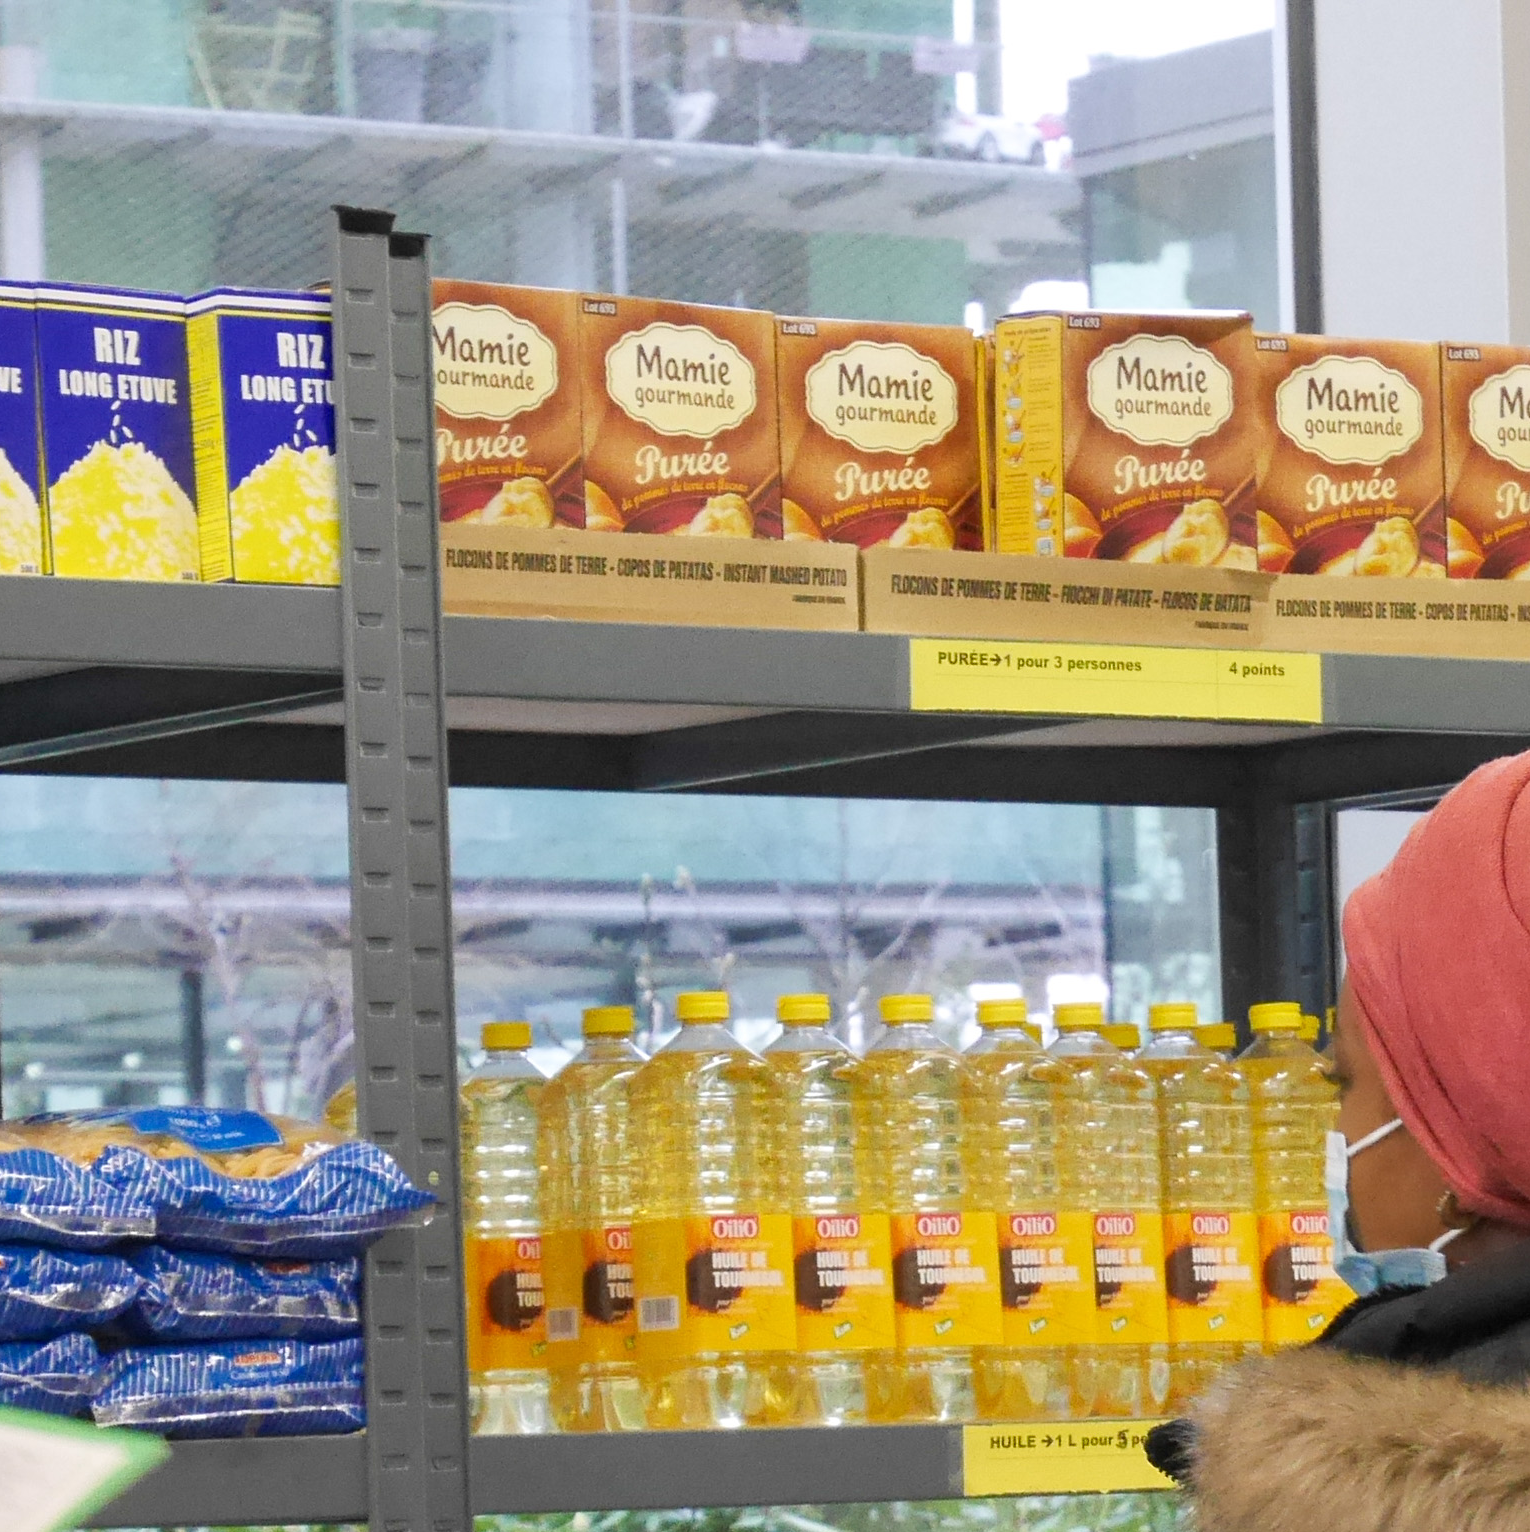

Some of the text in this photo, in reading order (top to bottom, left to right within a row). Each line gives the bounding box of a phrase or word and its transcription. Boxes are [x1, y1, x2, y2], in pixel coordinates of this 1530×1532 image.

[1069, 316, 1100, 328] Lot 693
[94, 327, 141, 366] RIZ
[276, 332, 325, 370] RIZ
[433, 326, 530, 366] Mamie
[1257, 339, 1270, 350] Lot
[1449, 348, 1480, 360] Lot 693
[636, 344, 731, 386] Mamie
[1117, 356, 1208, 393] Mamie
[59, 369, 177, 405] LONG ETUVE
[241, 374, 297, 403] LONG
[437, 369, 535, 391] ourmande
[837, 363, 934, 401] Mamie
[635, 387, 735, 410] gourmande
[1115, 397, 1212, 420] gourmande
[1307, 377, 1400, 414] Mamie
[835, 404, 937, 426] gourmande
[1304, 417, 1403, 439] gourmande
[634, 441, 730, 484] Purée
[1114, 449, 1207, 495] Purée
[834, 457, 931, 501] Purée
[1305, 467, 1398, 513] Purée
[445, 548, 847, 587] FLOCONS DE POMMES DE TERRE COPOS DE PATATAS INSTANT MASHED POTATO
[891, 573, 939, 596] FLOCONS
[941, 577, 954, 597] DE
[957, 578, 1001, 600] POMMES
[1004, 581, 1017, 601] DE
[1020, 582, 1051, 603] TERRE
[1115, 588, 1153, 609] PATATE
[1199, 592, 1213, 612] DE
[1215, 593, 1251, 614] BATATA
[937, 649, 1285, 678] PURÉE 1 pour 3 personnes 4 points
[713, 1218, 758, 1238] OiliO
[817, 1218, 859, 1237] OiliO
[918, 1217, 960, 1236] OiliO
[1012, 1217, 1055, 1236] OiliO
[1096, 1216, 1134, 1235] OiliO
[1192, 1216, 1229, 1235] OiliO
[1292, 1216, 1329, 1235] OiliO
[990, 1435, 1036, 1449] HUILE
[1055, 1434, 1062, 1447] 1
[1069, 1434, 1077, 1447] L
[1082, 1434, 1114, 1449] pour
